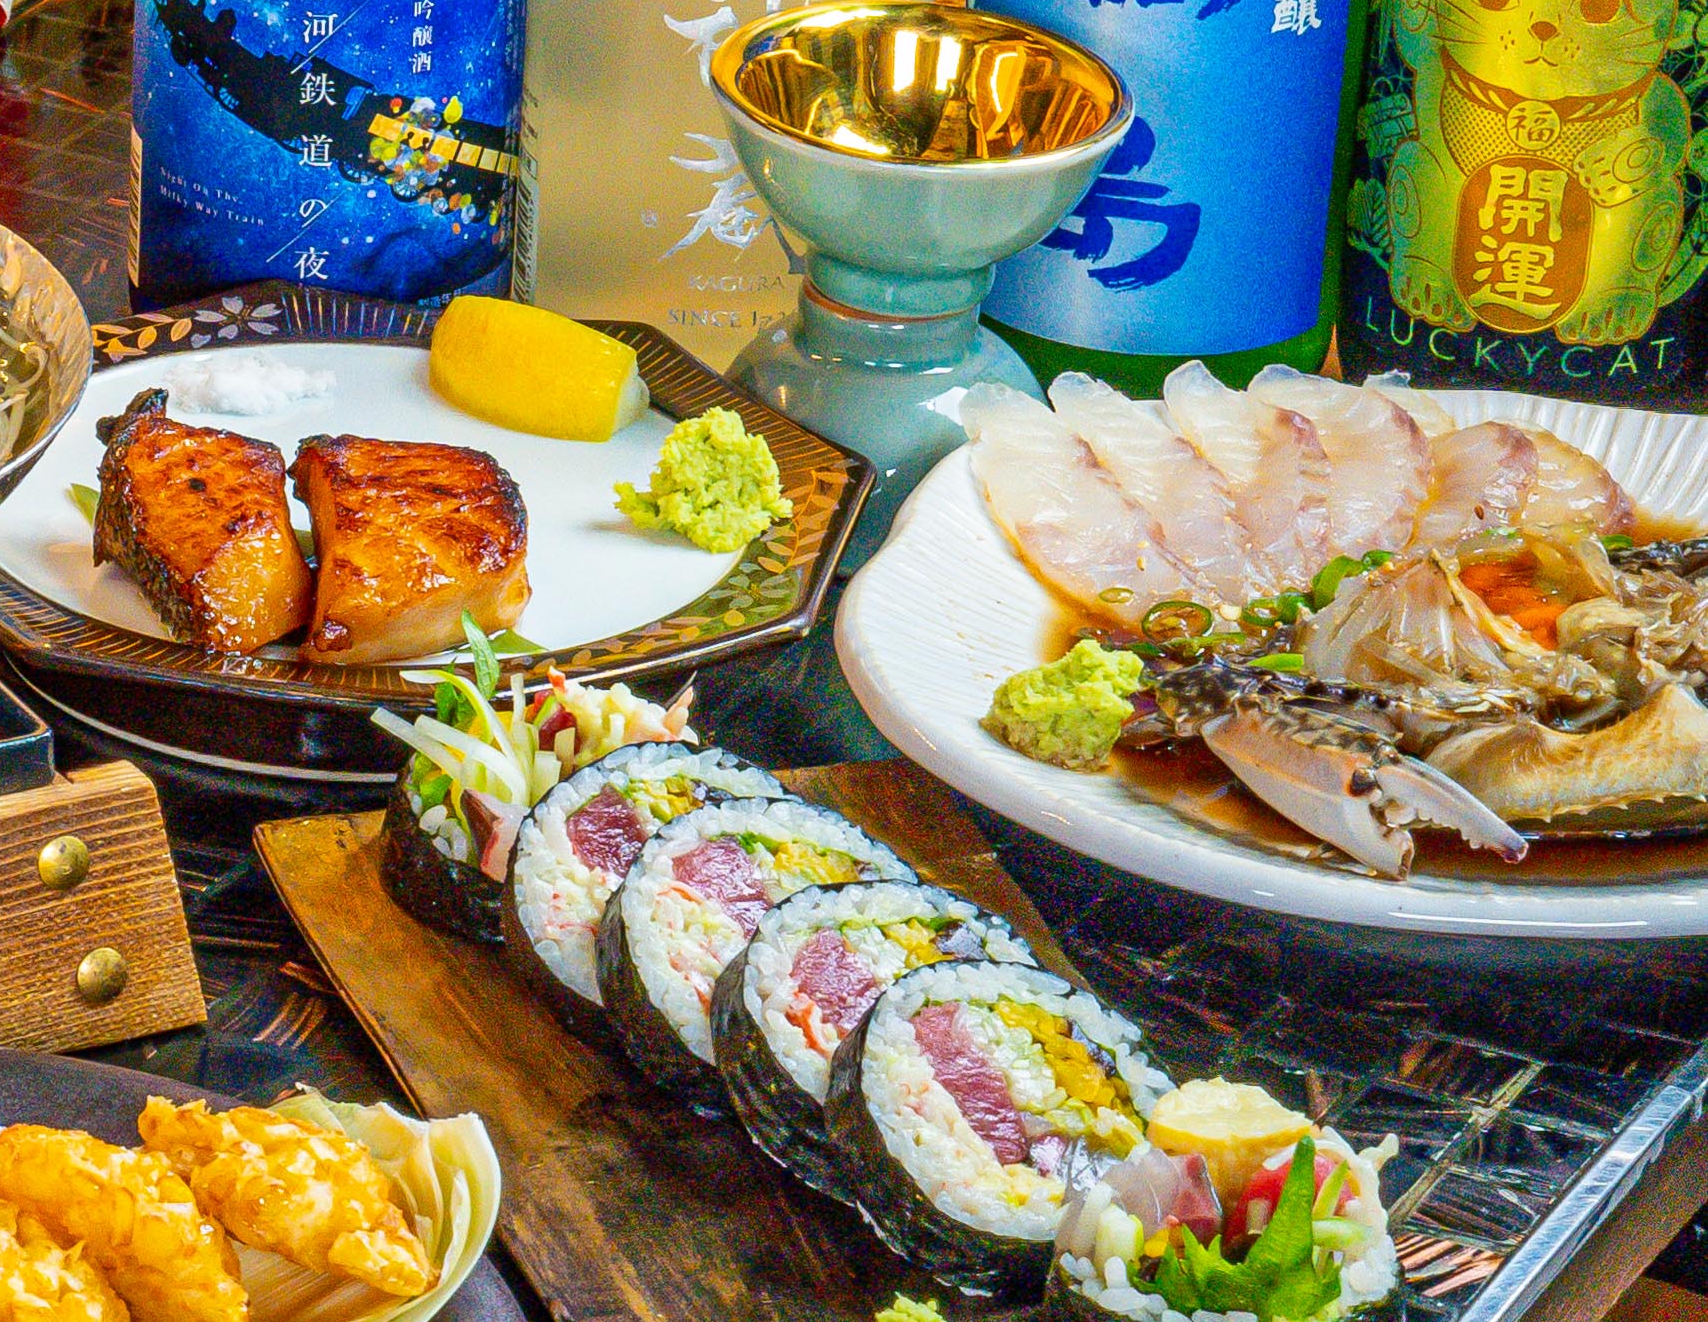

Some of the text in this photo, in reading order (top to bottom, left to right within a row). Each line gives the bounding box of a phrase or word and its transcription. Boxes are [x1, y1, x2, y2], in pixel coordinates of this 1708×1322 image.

[1512, 106, 1557, 142] 福
[1471, 164, 1569, 318] 開運
[667, 308, 742, 328] SINCE
